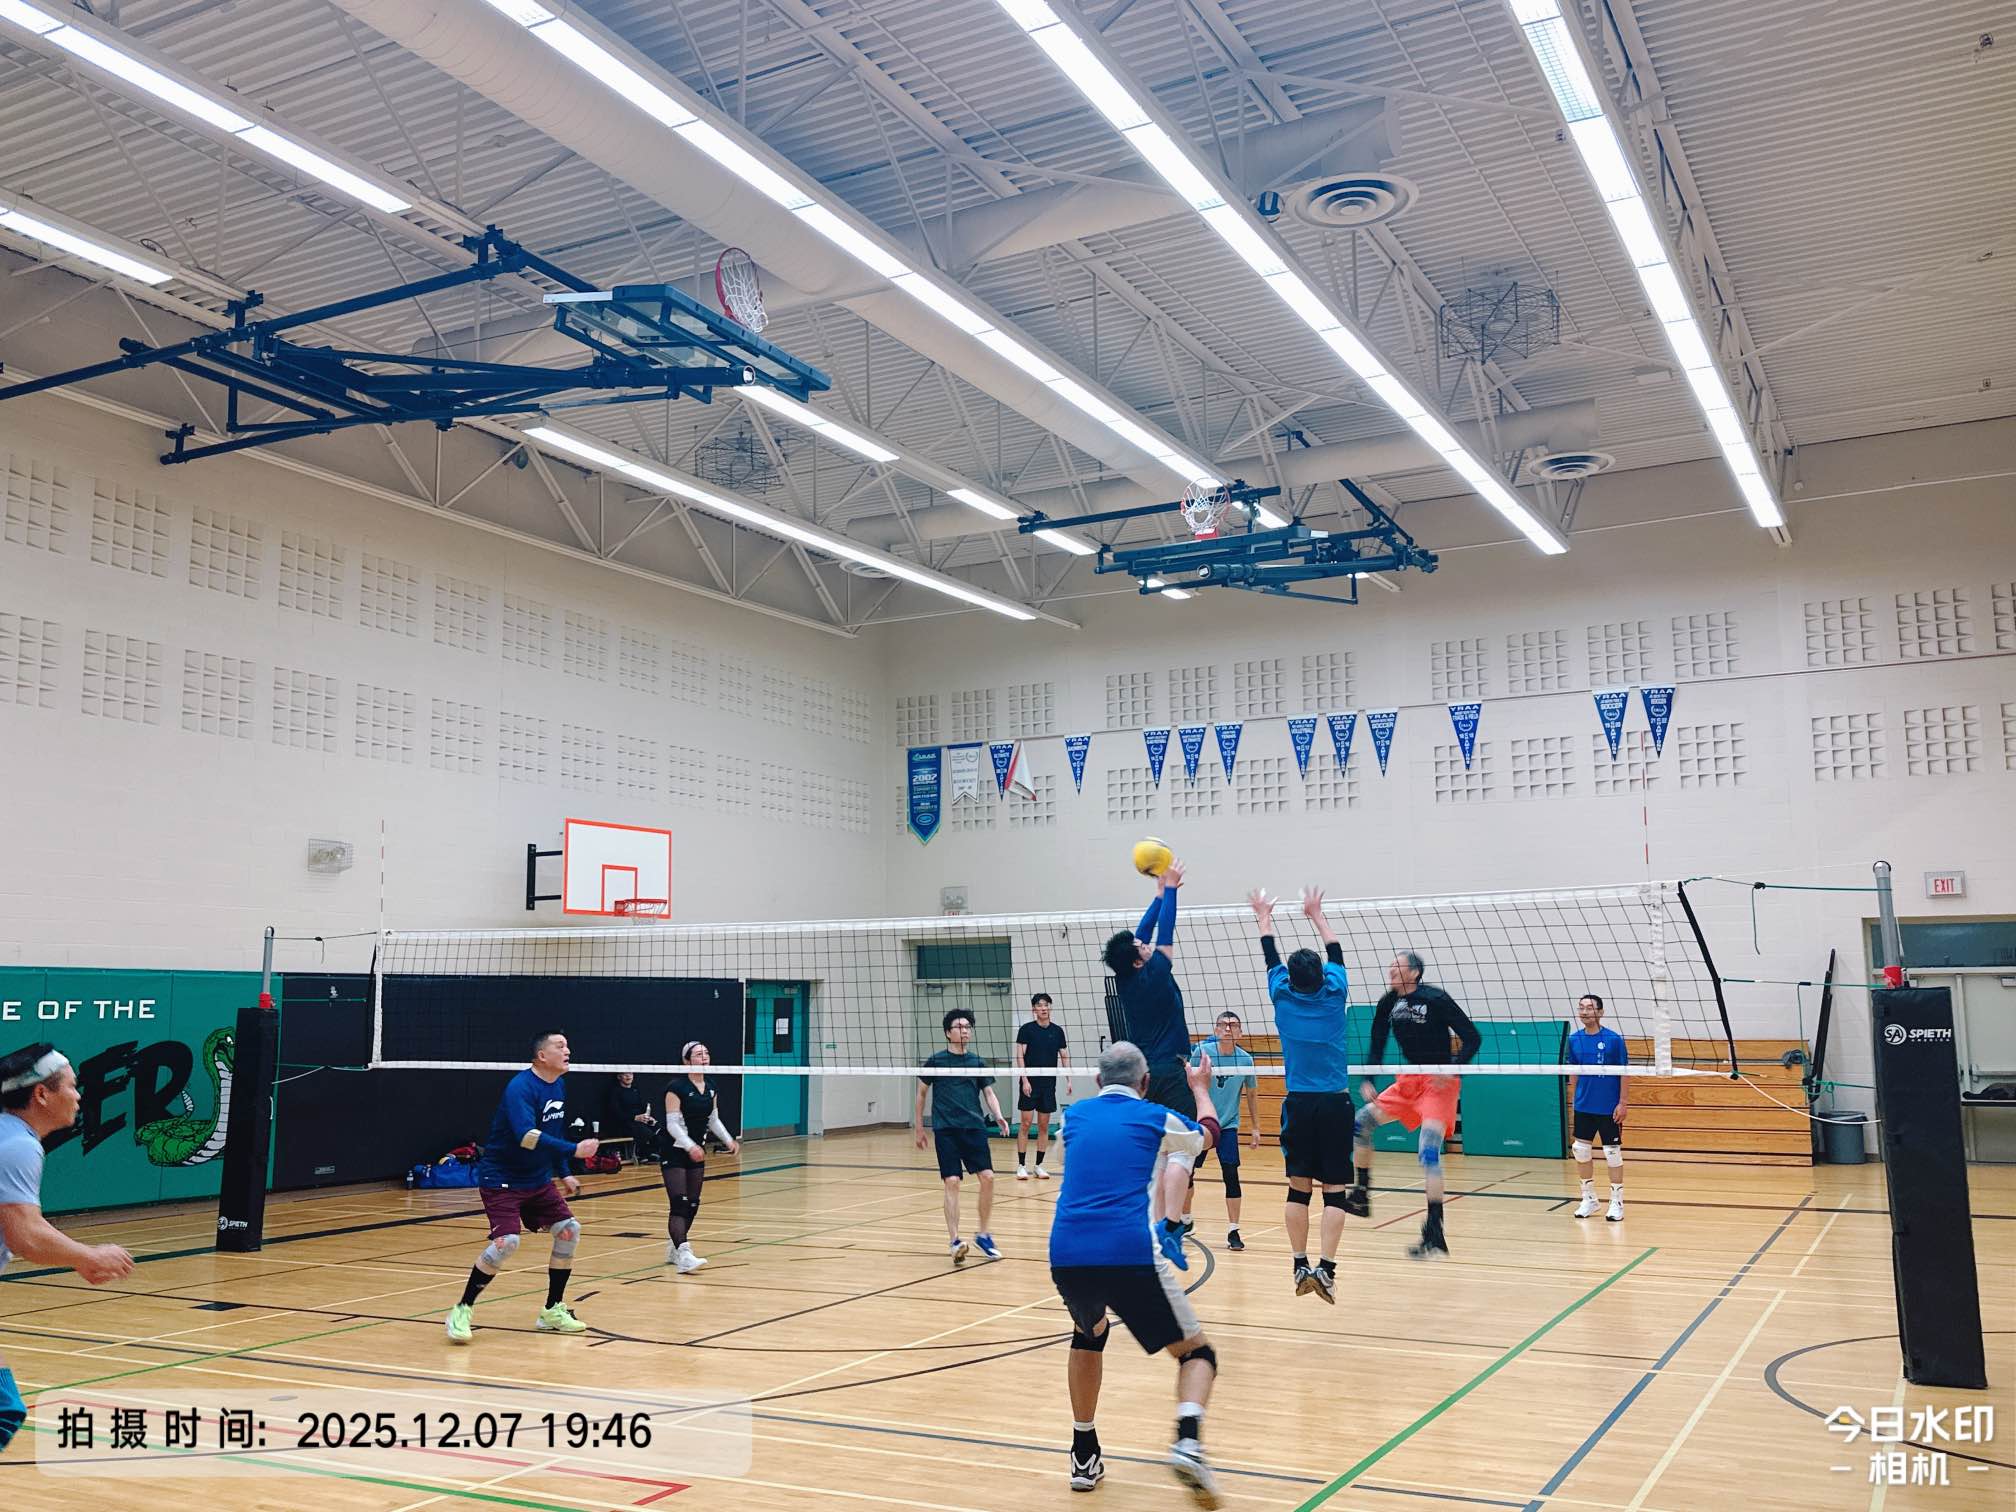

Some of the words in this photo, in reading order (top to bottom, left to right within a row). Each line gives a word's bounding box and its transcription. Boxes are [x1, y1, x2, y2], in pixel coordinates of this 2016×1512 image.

[1935, 879, 1954, 893] EXIT
[38, 1001, 82, 1020] OF
[93, 1000, 156, 1019] THE
[1908, 1028, 1952, 1038] SPIETH
